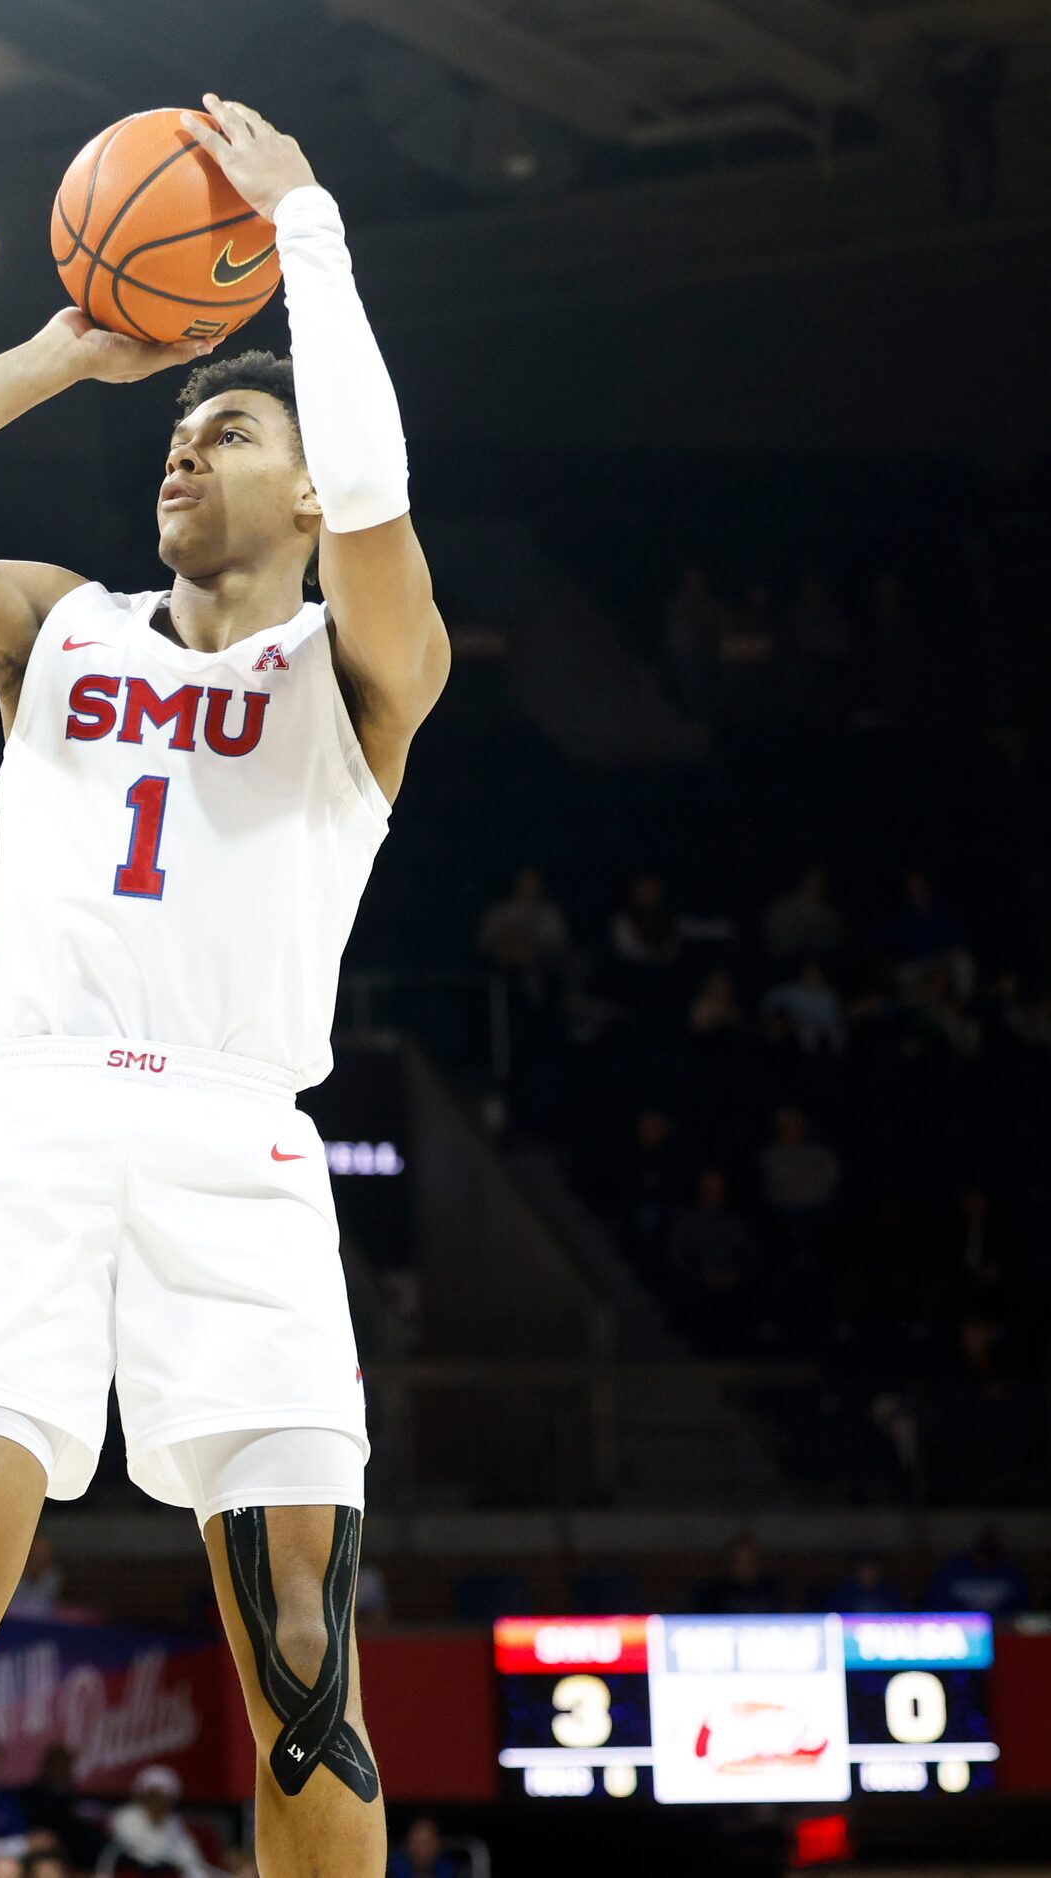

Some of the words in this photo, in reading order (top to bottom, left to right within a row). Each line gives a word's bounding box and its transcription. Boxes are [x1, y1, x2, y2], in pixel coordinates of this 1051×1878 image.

[65, 674, 270, 757] SMU
[113, 775, 170, 901] 1
[106, 1049, 167, 1074] SMU
[551, 1674, 613, 1748] 3
[885, 1671, 947, 1744] 0
[287, 1744, 305, 1762] KT
